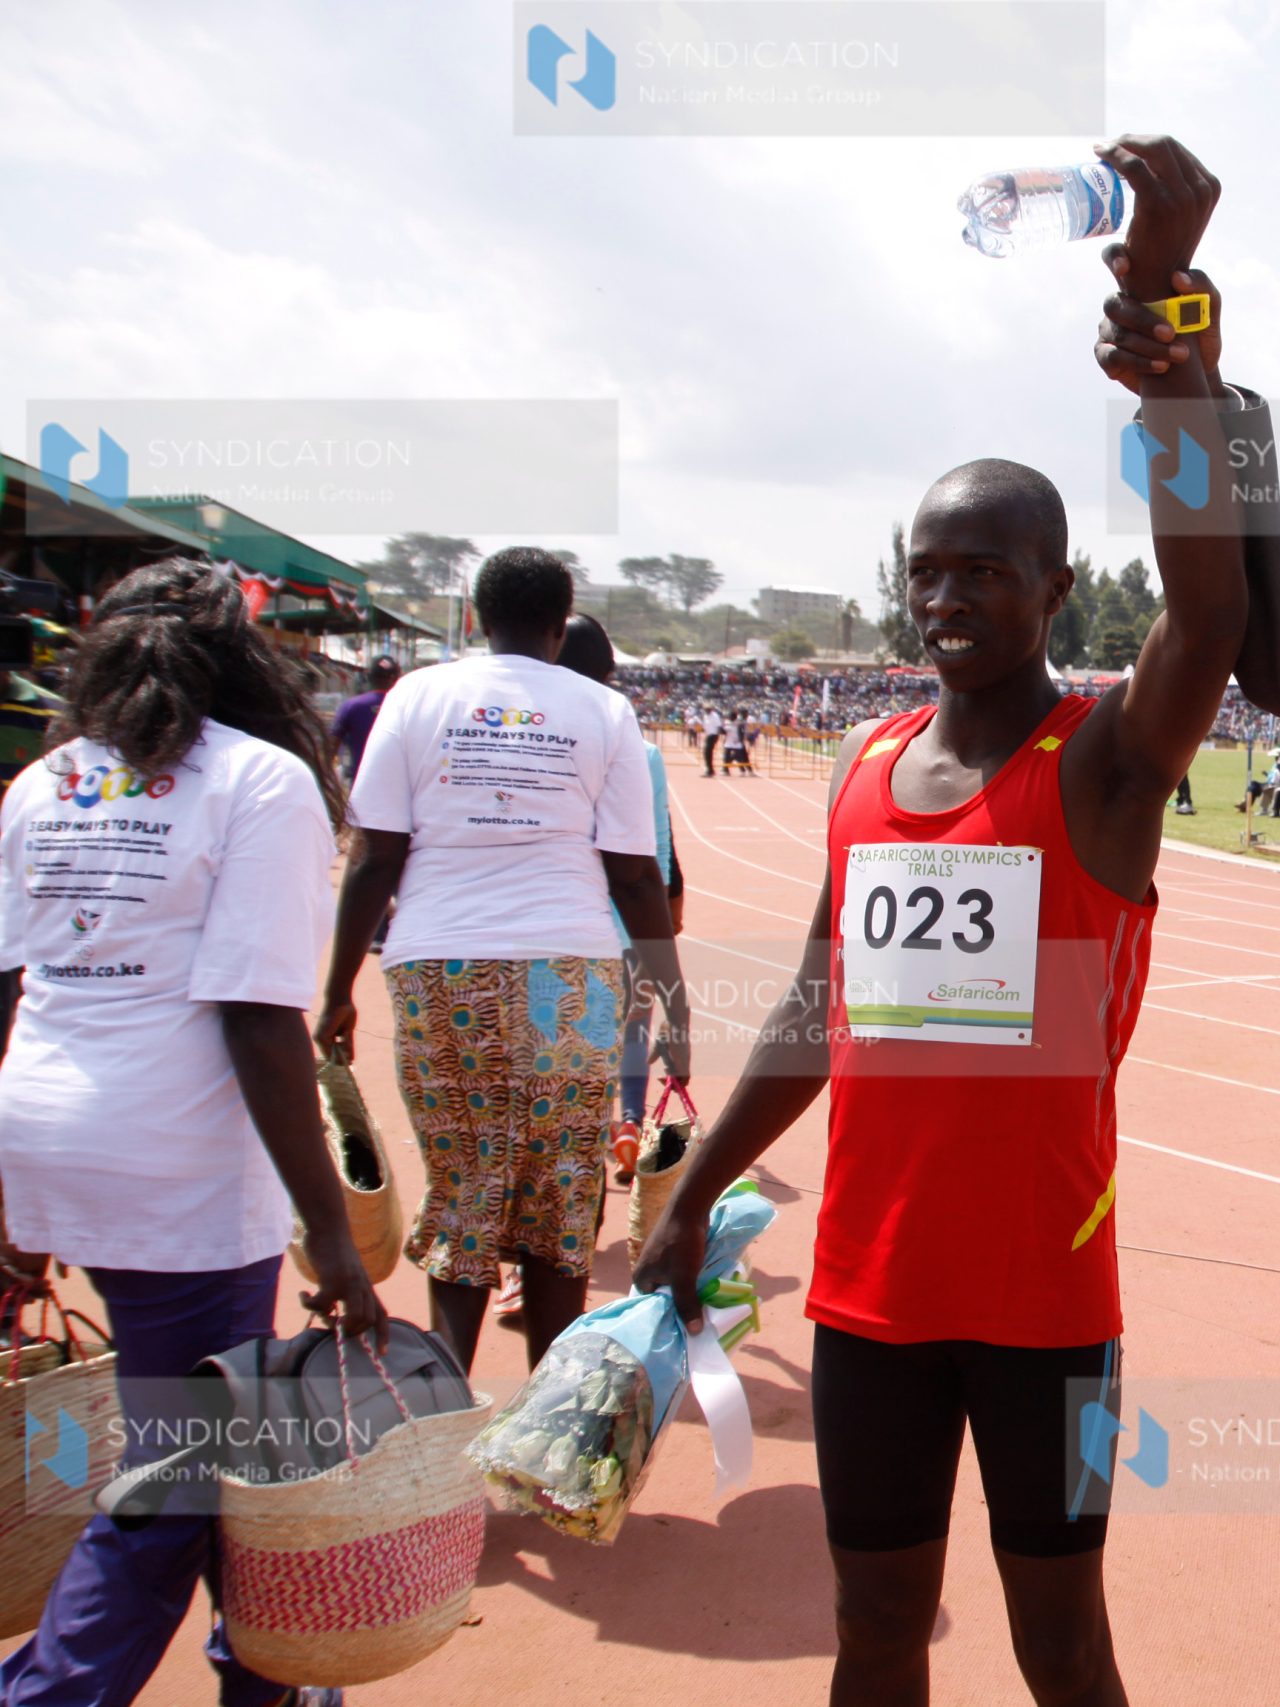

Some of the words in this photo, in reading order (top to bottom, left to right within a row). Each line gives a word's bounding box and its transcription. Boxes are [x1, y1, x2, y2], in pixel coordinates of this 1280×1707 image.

[446, 729, 454, 738] 3
[455, 729, 487, 738] EASY
[490, 730, 525, 740] WAYS
[527, 732, 545, 742] TO
[547, 735, 577, 748] PLAY
[37, 820, 72, 833] EASY
[73, 819, 109, 832] WAYS
[111, 819, 130, 831] TO
[132, 820, 172, 835] PLAY
[468, 816, 541, 826] mylotto.co.ke
[857, 848, 937, 864] SAFARICOM
[941, 849, 1022, 867] OLYMPICS
[907, 863, 953, 878] TRIALS
[863, 885, 995, 954] 023
[937, 983, 1020, 1001] Safaricom
